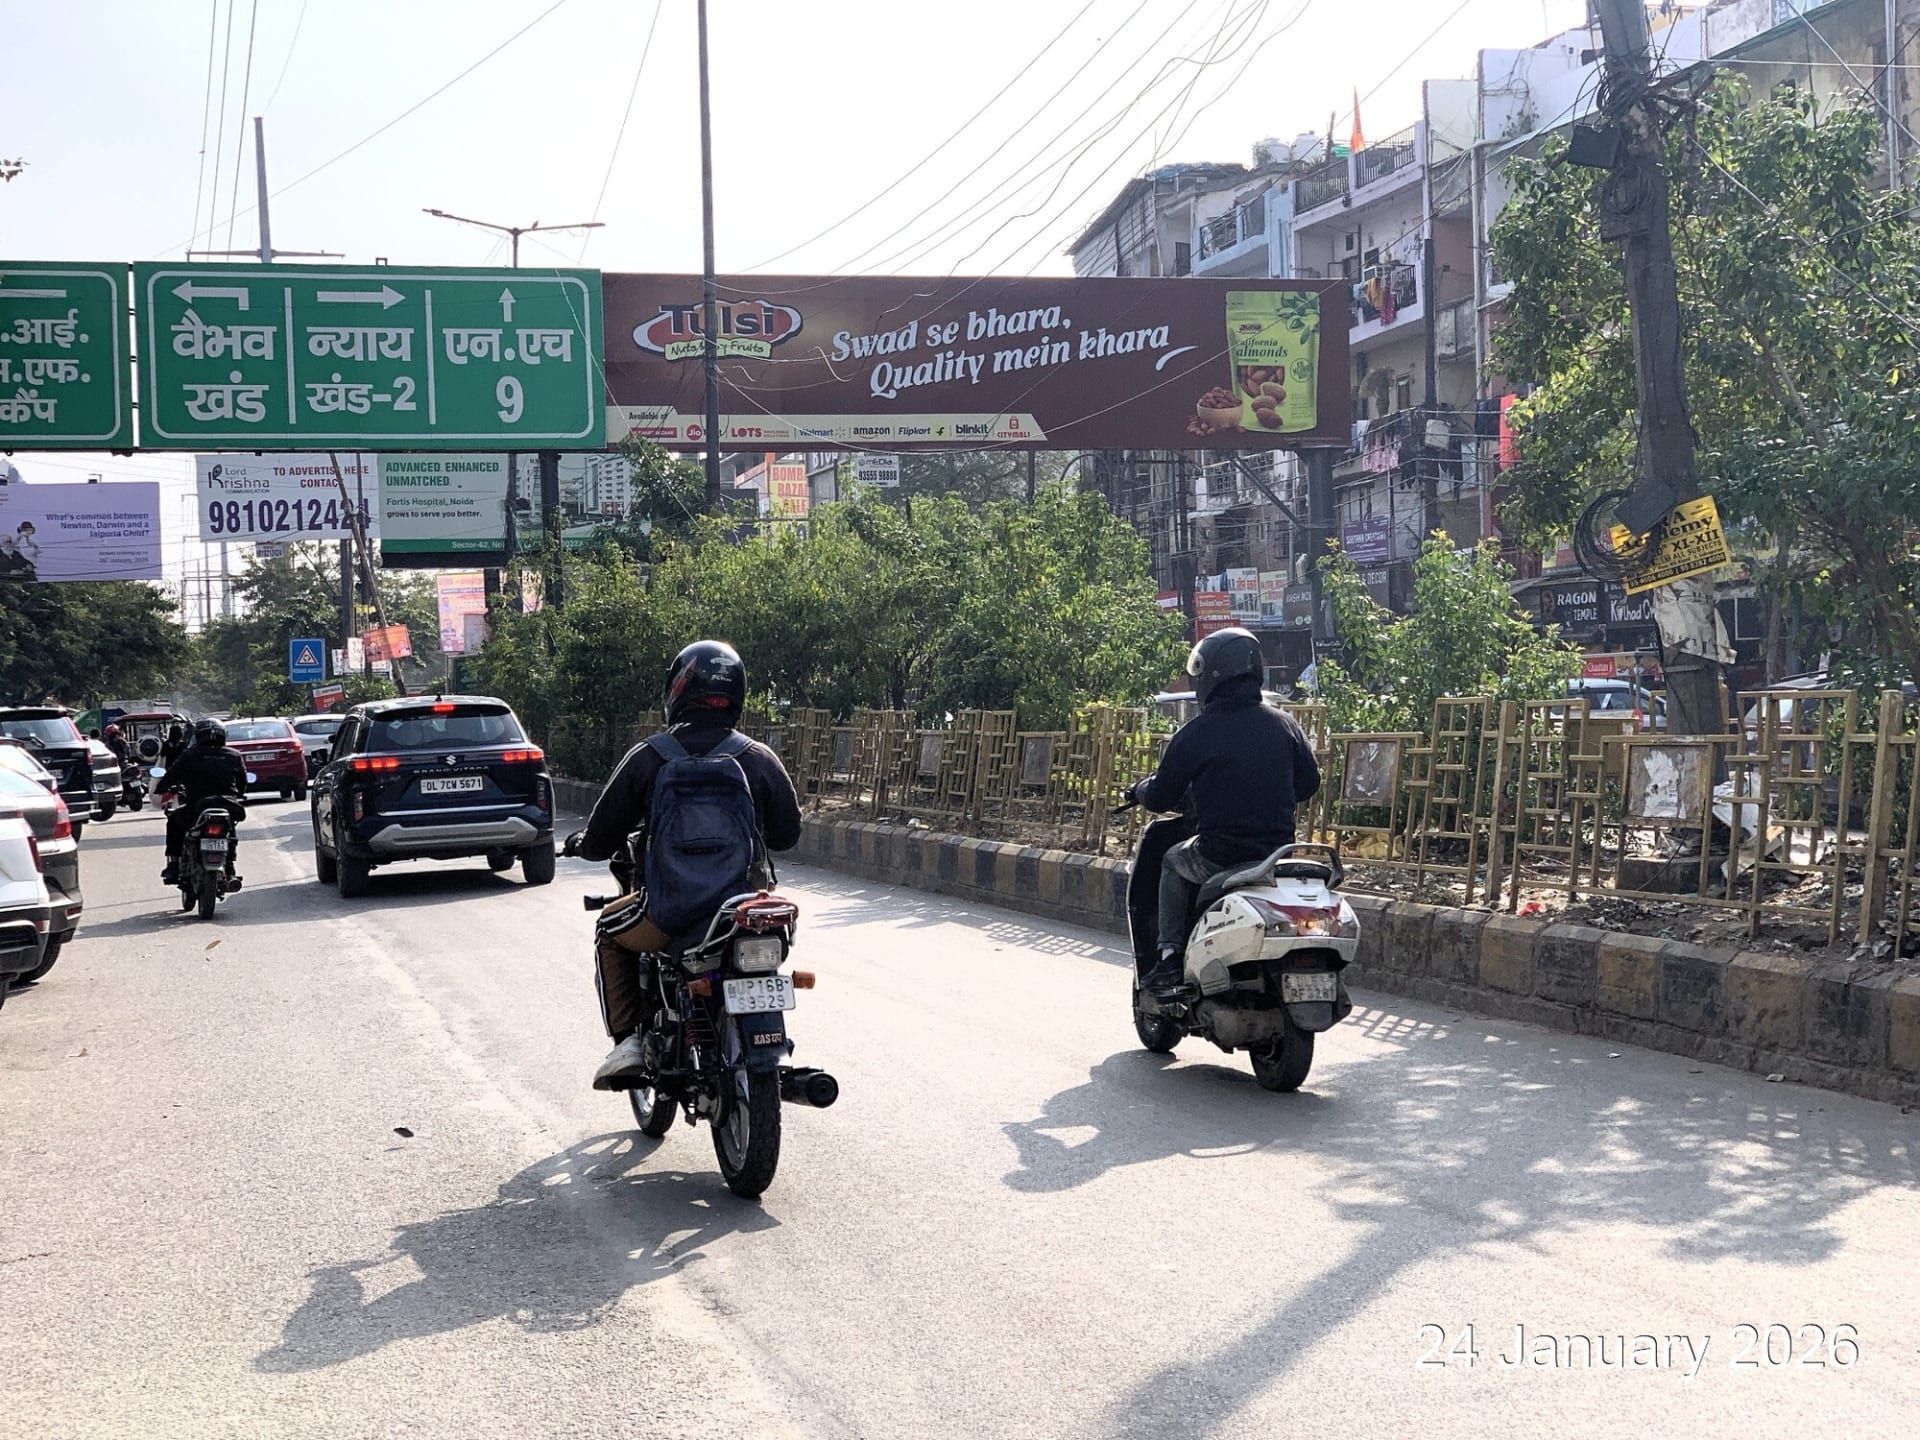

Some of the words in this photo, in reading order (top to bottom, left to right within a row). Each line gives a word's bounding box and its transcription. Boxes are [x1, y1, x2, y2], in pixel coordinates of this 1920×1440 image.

[171, 308, 277, 361] वैभव
[831, 320, 918, 363] Swad
[926, 322, 960, 347] se
[966, 305, 1072, 341] bhara,
[306, 326, 415, 362] न्याय
[442, 328, 574, 365] एन.एच
[671, 343, 697, 355] Nuts
[729, 340, 764, 354] Fruits
[1236, 346, 1288, 358] almonds
[870, 350, 985, 399] Quality
[993, 340, 1070, 374] mein
[1079, 325, 1169, 360] khara
[182, 370, 269, 423] खंड
[305, 372, 417, 415] खंड-2
[496, 375, 524, 424] 9
[688, 428, 701, 436] Jio
[731, 427, 762, 437] LOTS
[800, 427, 834, 437] Walmart
[853, 426, 890, 436] amazon
[898, 427, 931, 437] Flipkart
[955, 424, 989, 434] blinkit
[225, 468, 246, 476] Lord
[273, 467, 285, 476] TO
[289, 466, 337, 476] ADVERTIS
[300, 479, 340, 488] CONTAC
[386, 498, 410, 506] Fortis
[450, 497, 474, 505] Noida
[45, 512, 74, 521] What's
[113, 512, 149, 520] between
[387, 511, 409, 519] grows
[60, 521, 95, 530] Newton,
[97, 520, 126, 529] Darwin
[127, 521, 143, 529] and
[123, 529, 150, 538] Child?
[1673, 551, 1686, 560] ALL
[1573, 608, 1597, 620] TEMPLE
[426, 780, 438, 791] DL
[460, 778, 481, 789] 5671
